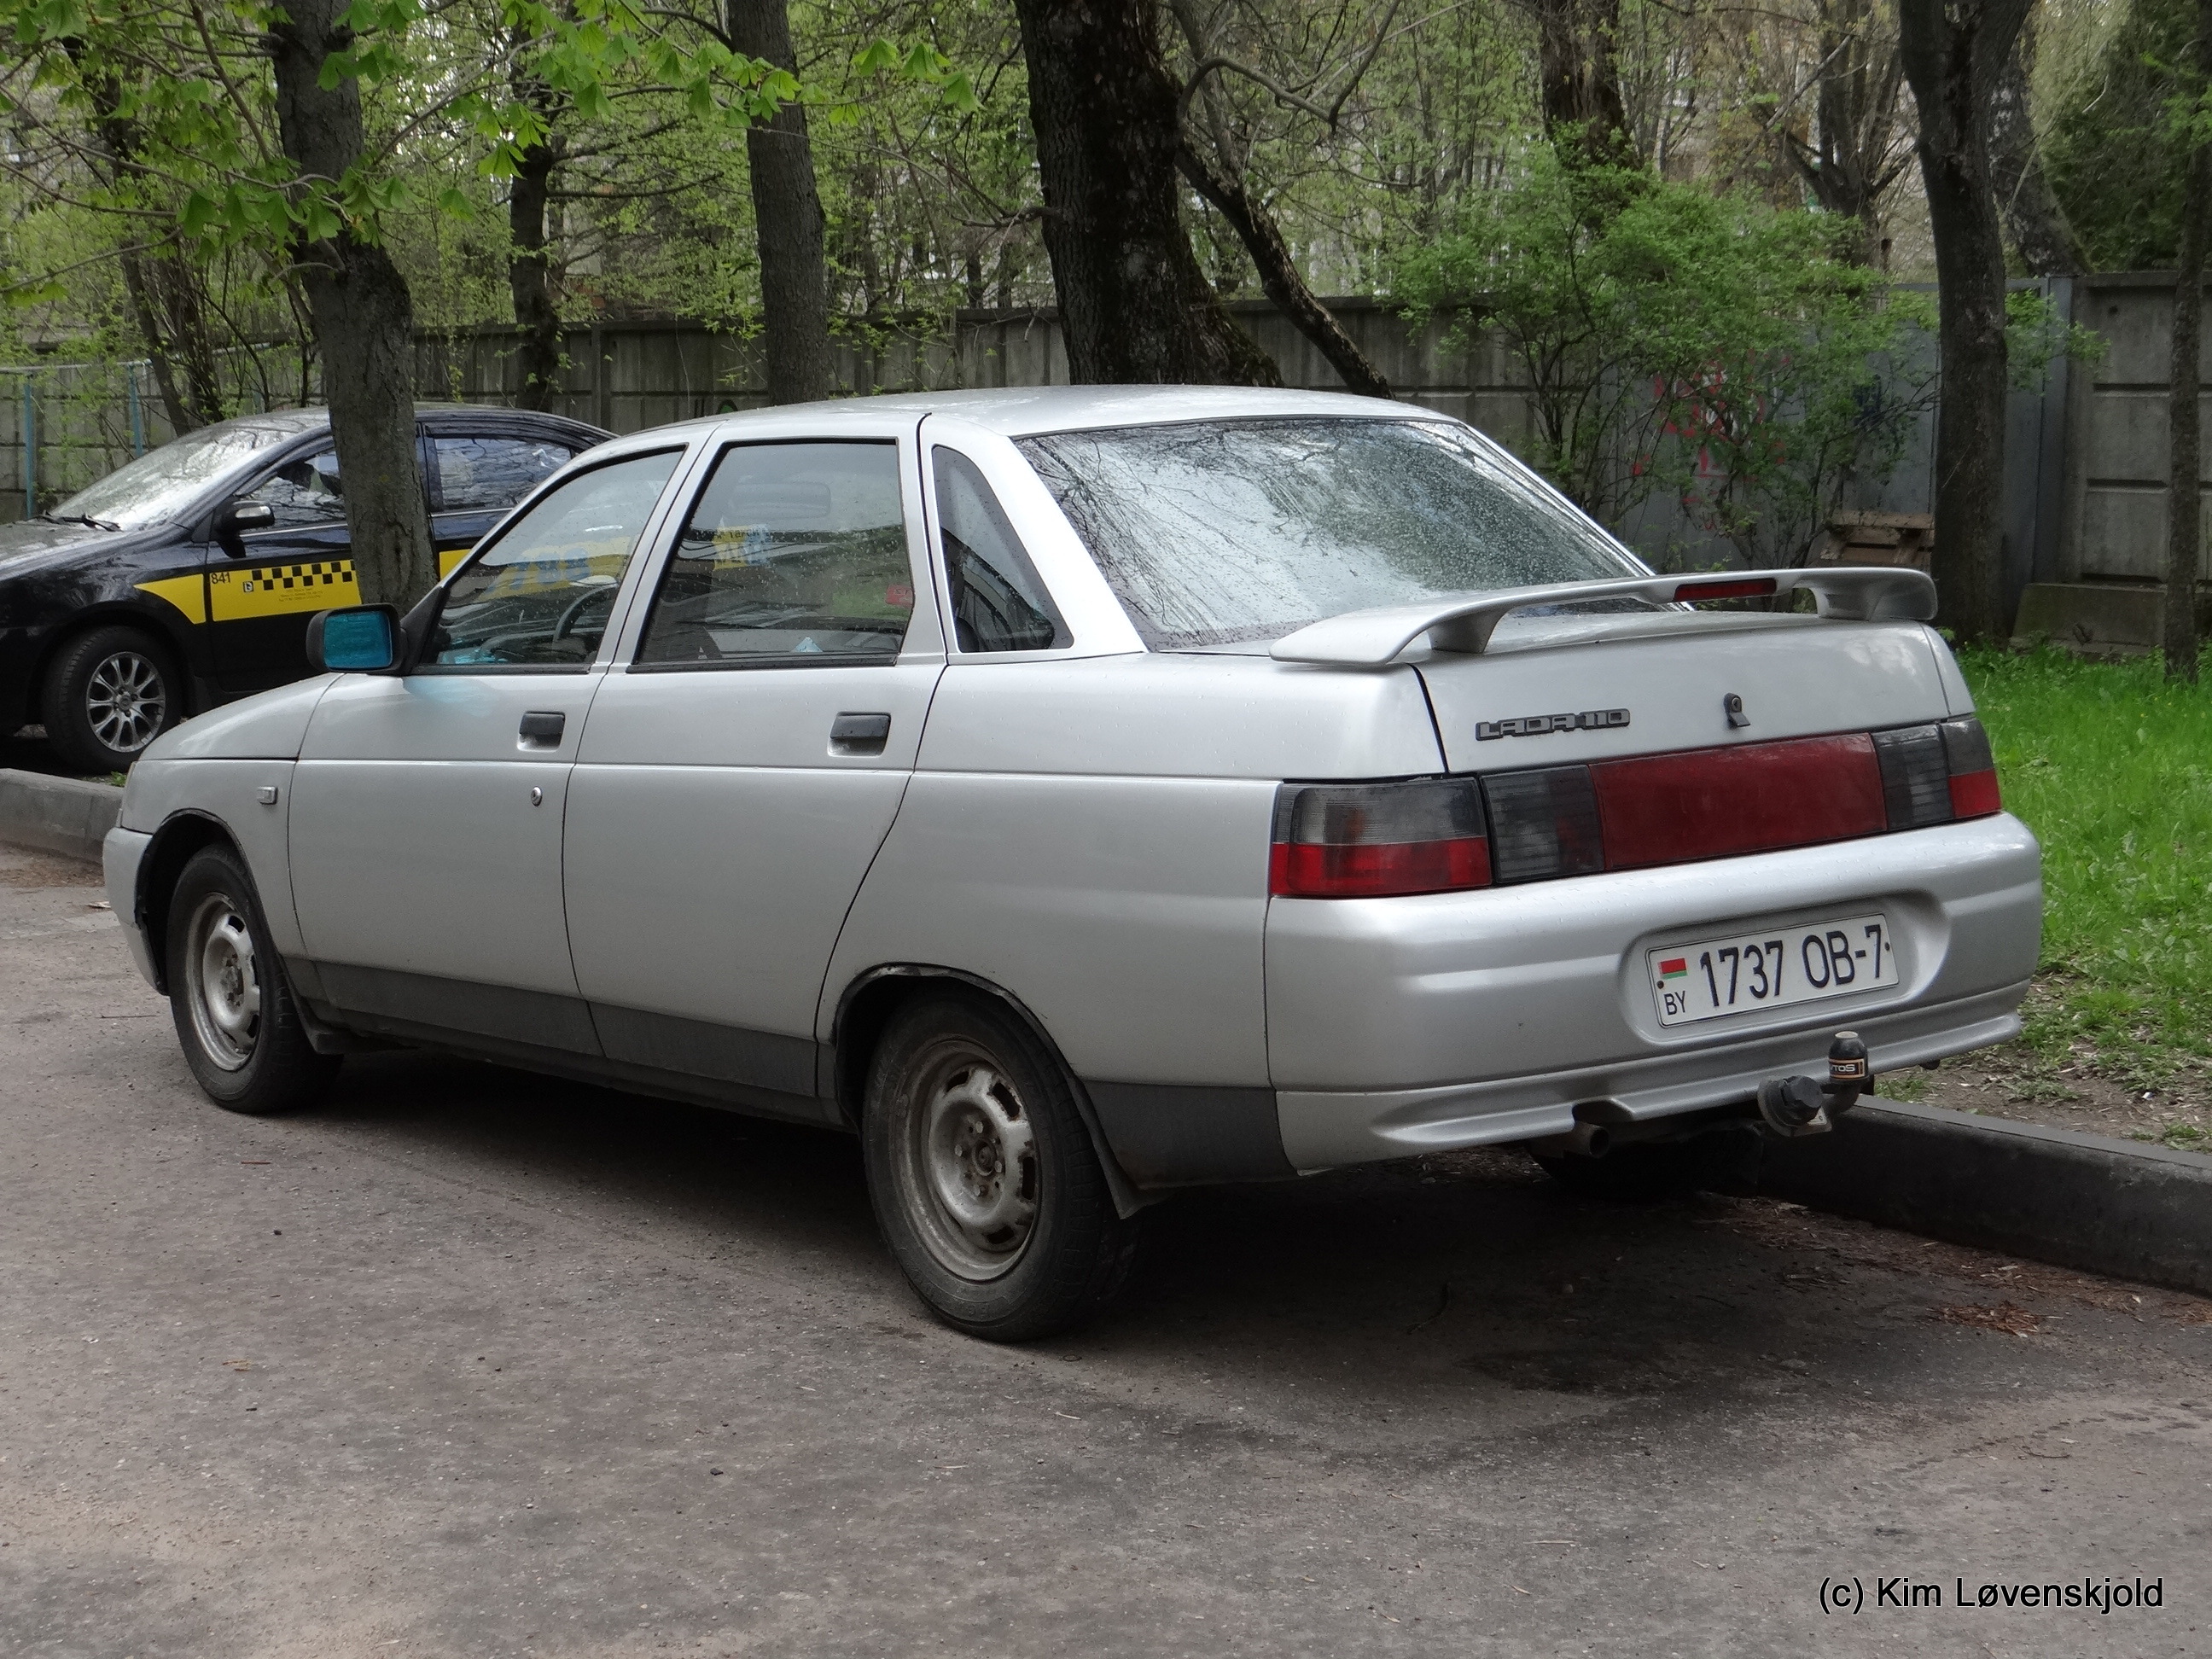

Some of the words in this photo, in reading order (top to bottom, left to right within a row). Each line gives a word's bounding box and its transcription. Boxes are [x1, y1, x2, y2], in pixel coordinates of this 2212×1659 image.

[211, 573, 231, 585] 841
[1476, 713, 1576, 741] LADA
[1578, 708, 1631, 731] 110
[1700, 940, 1784, 1007] 1737
[1801, 923, 1882, 988] OB-7
[1664, 990, 1686, 1016] BY
